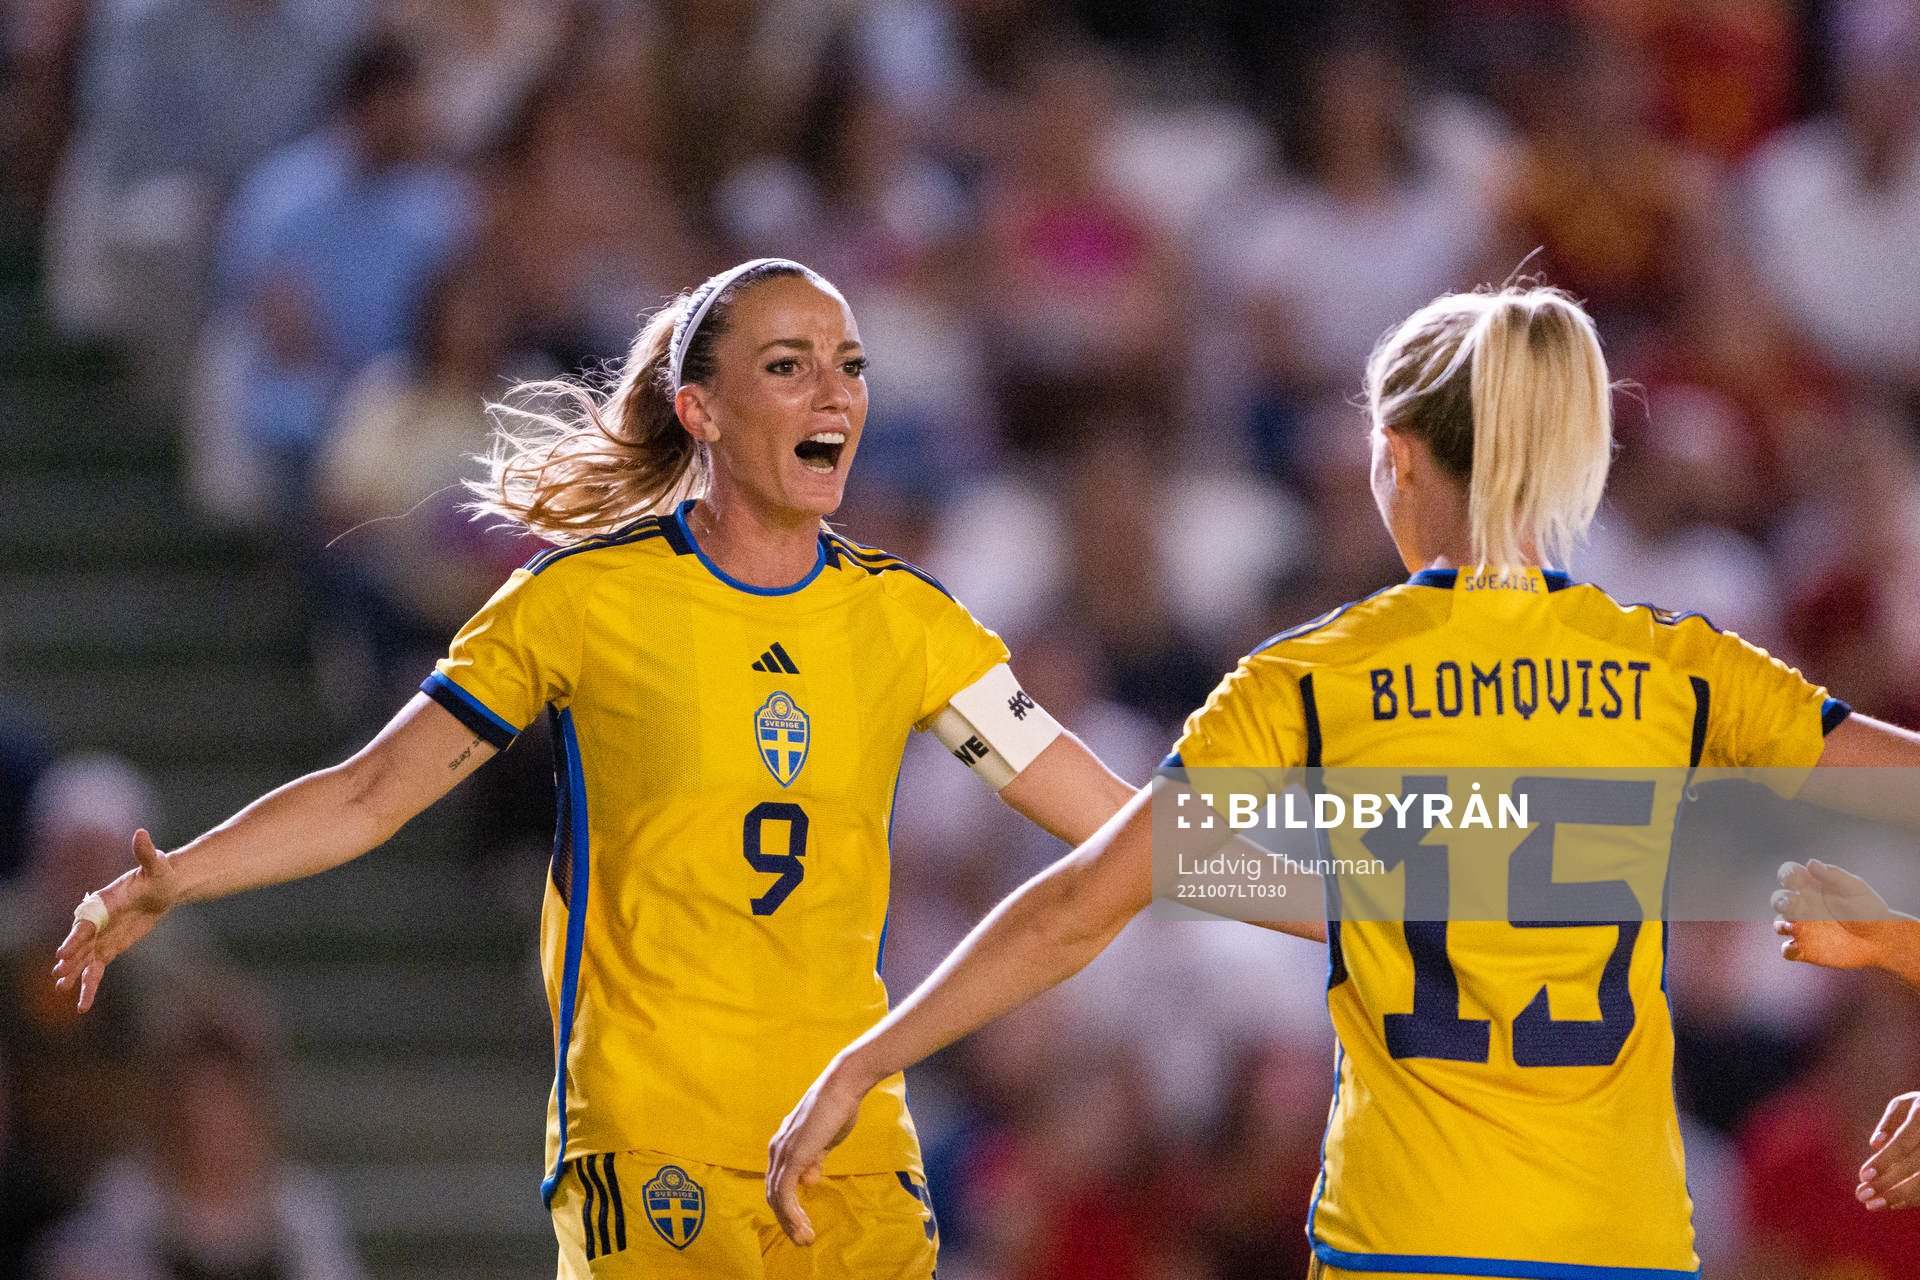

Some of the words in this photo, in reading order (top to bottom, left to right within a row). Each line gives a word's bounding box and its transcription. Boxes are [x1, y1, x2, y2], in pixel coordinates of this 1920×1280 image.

[1369, 658, 1651, 721] BLOMQVIST
[764, 720, 799, 729] SVERIGE
[743, 801, 809, 916] 9
[1359, 775, 1656, 1068] 15
[655, 1190, 693, 1198] SVERIGE
